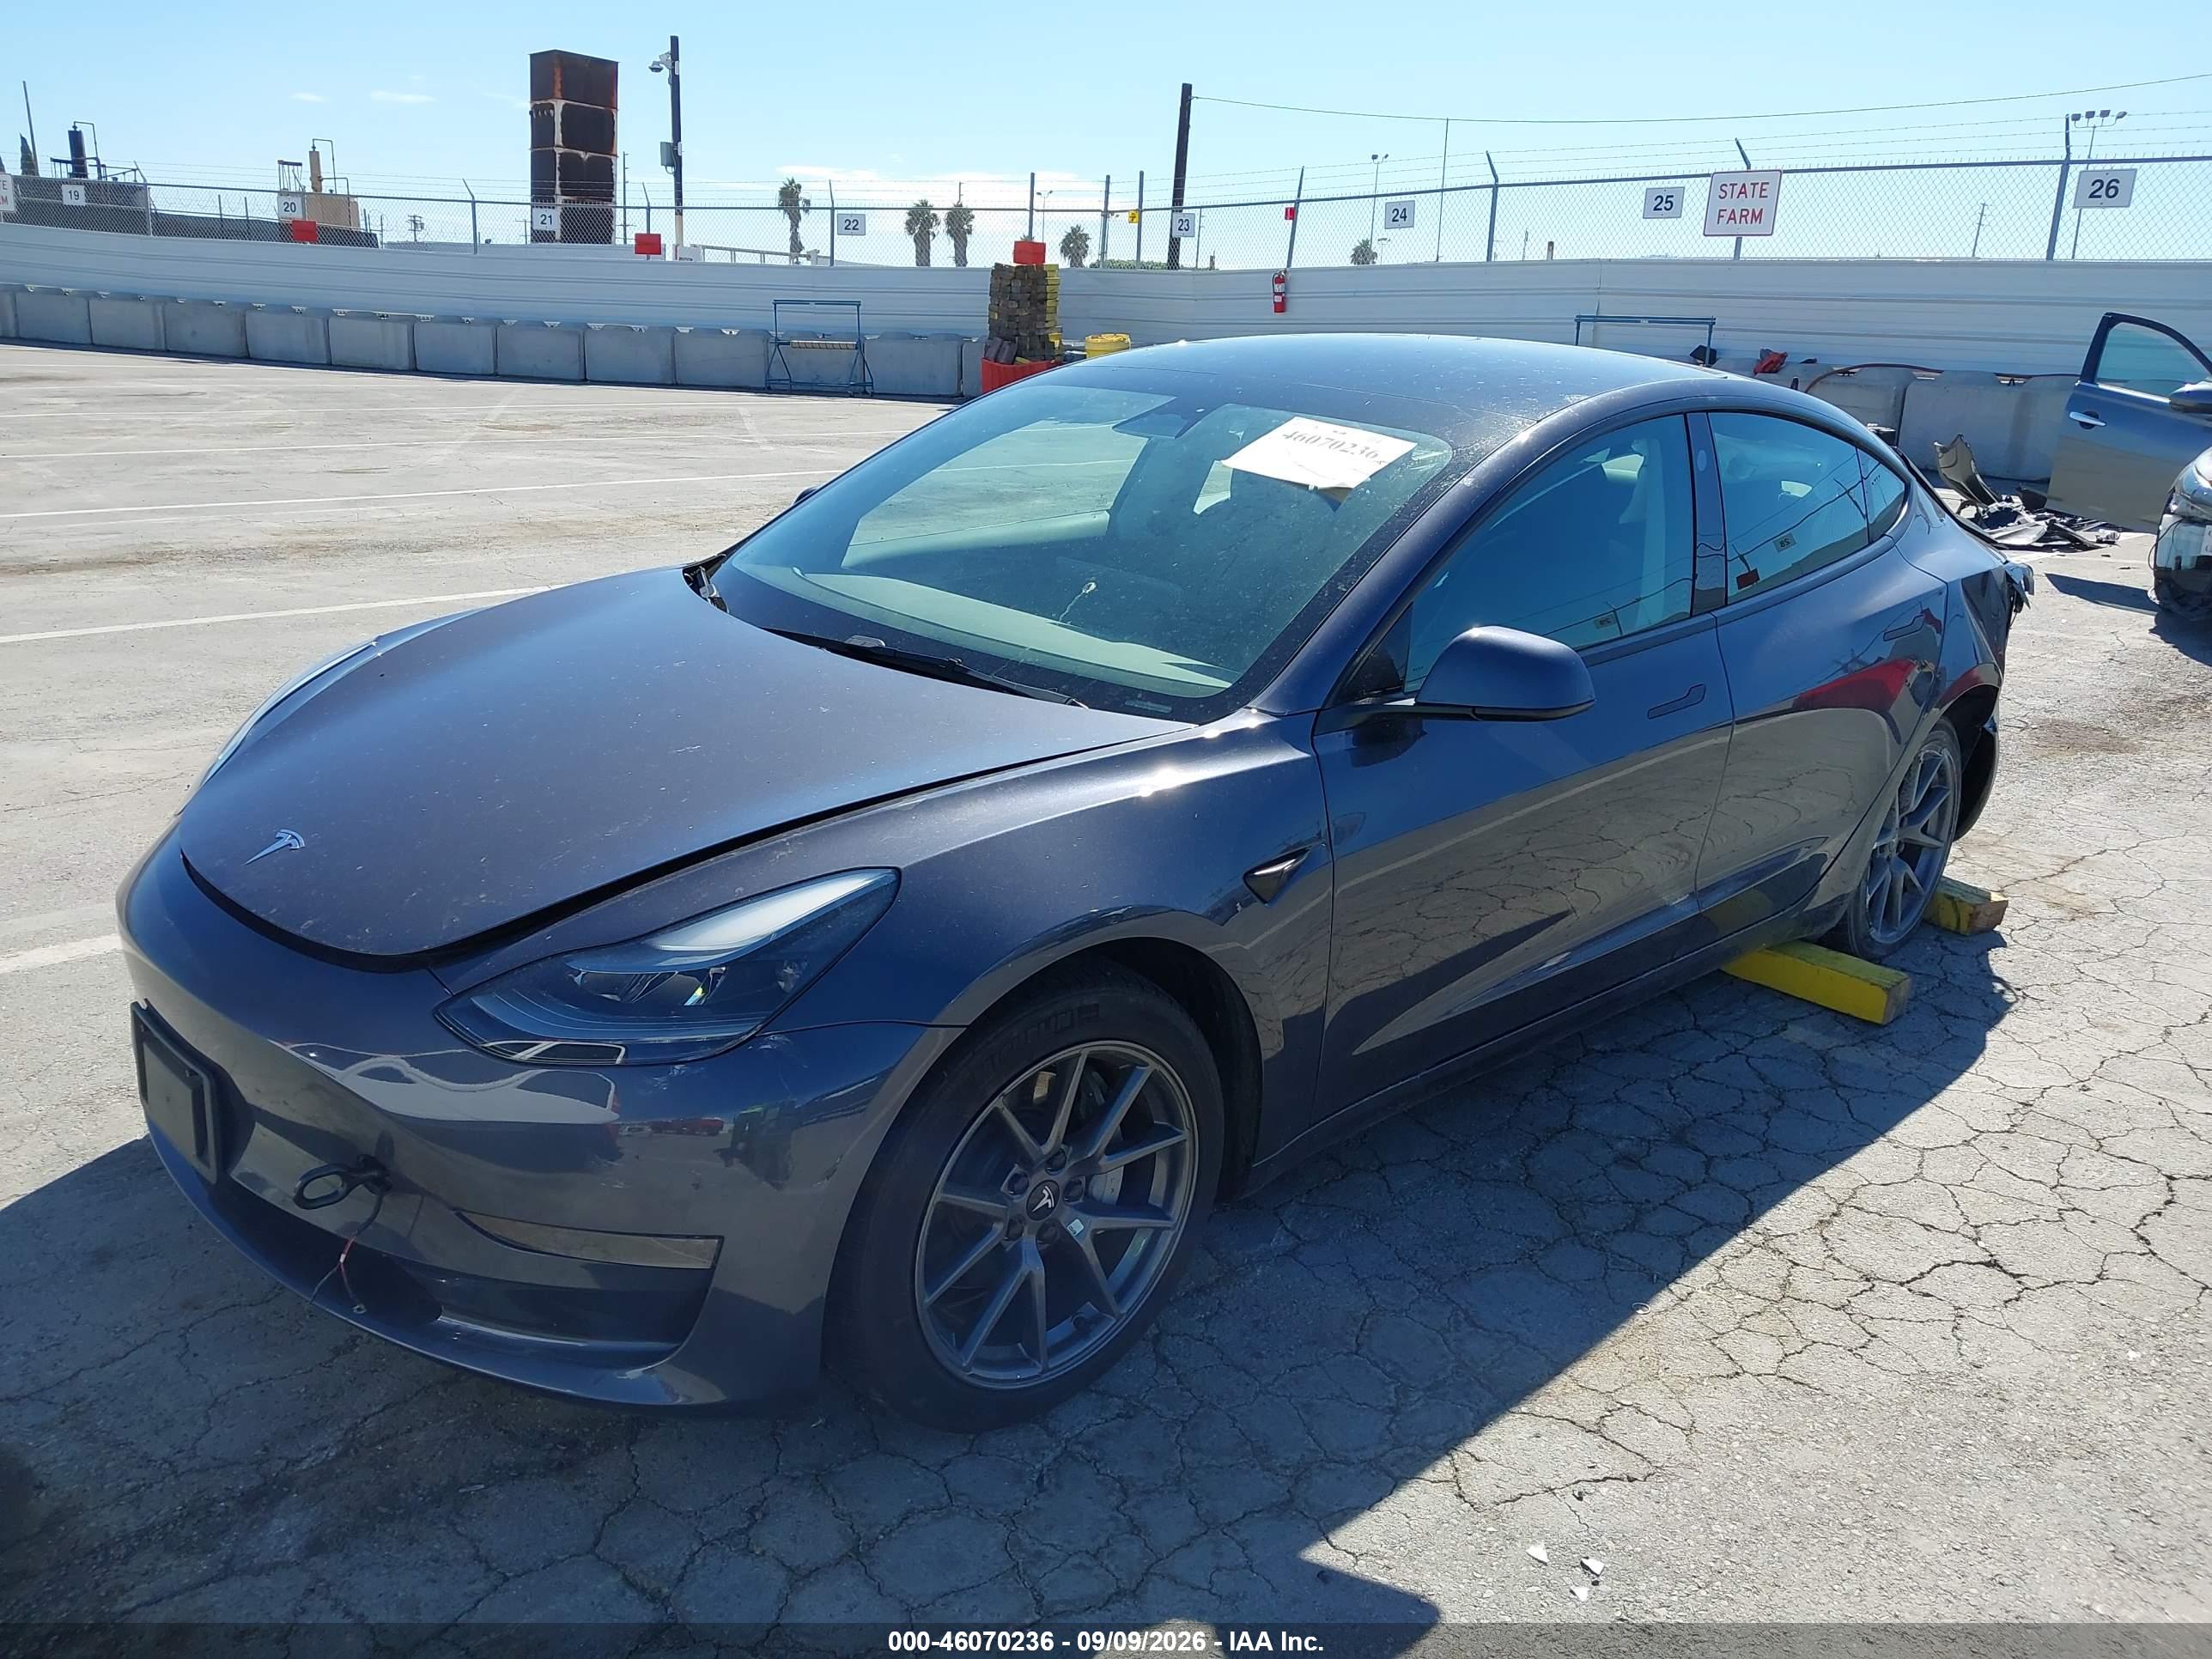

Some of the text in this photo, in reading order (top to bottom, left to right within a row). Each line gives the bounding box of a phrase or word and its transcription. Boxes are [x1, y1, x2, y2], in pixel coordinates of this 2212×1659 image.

[68, 190, 80, 201] 19
[1717, 181, 1770, 200] STATE
[2087, 177, 2120, 200] 26
[283, 201, 297, 214] 20
[1652, 194, 1674, 212] 25
[540, 213, 553, 226] 21
[1391, 207, 1407, 222] 24
[1717, 208, 1764, 225] FARM
[843, 218, 860, 232] 22
[1177, 218, 1190, 232] 23
[1283, 431, 1379, 459] 46070236
